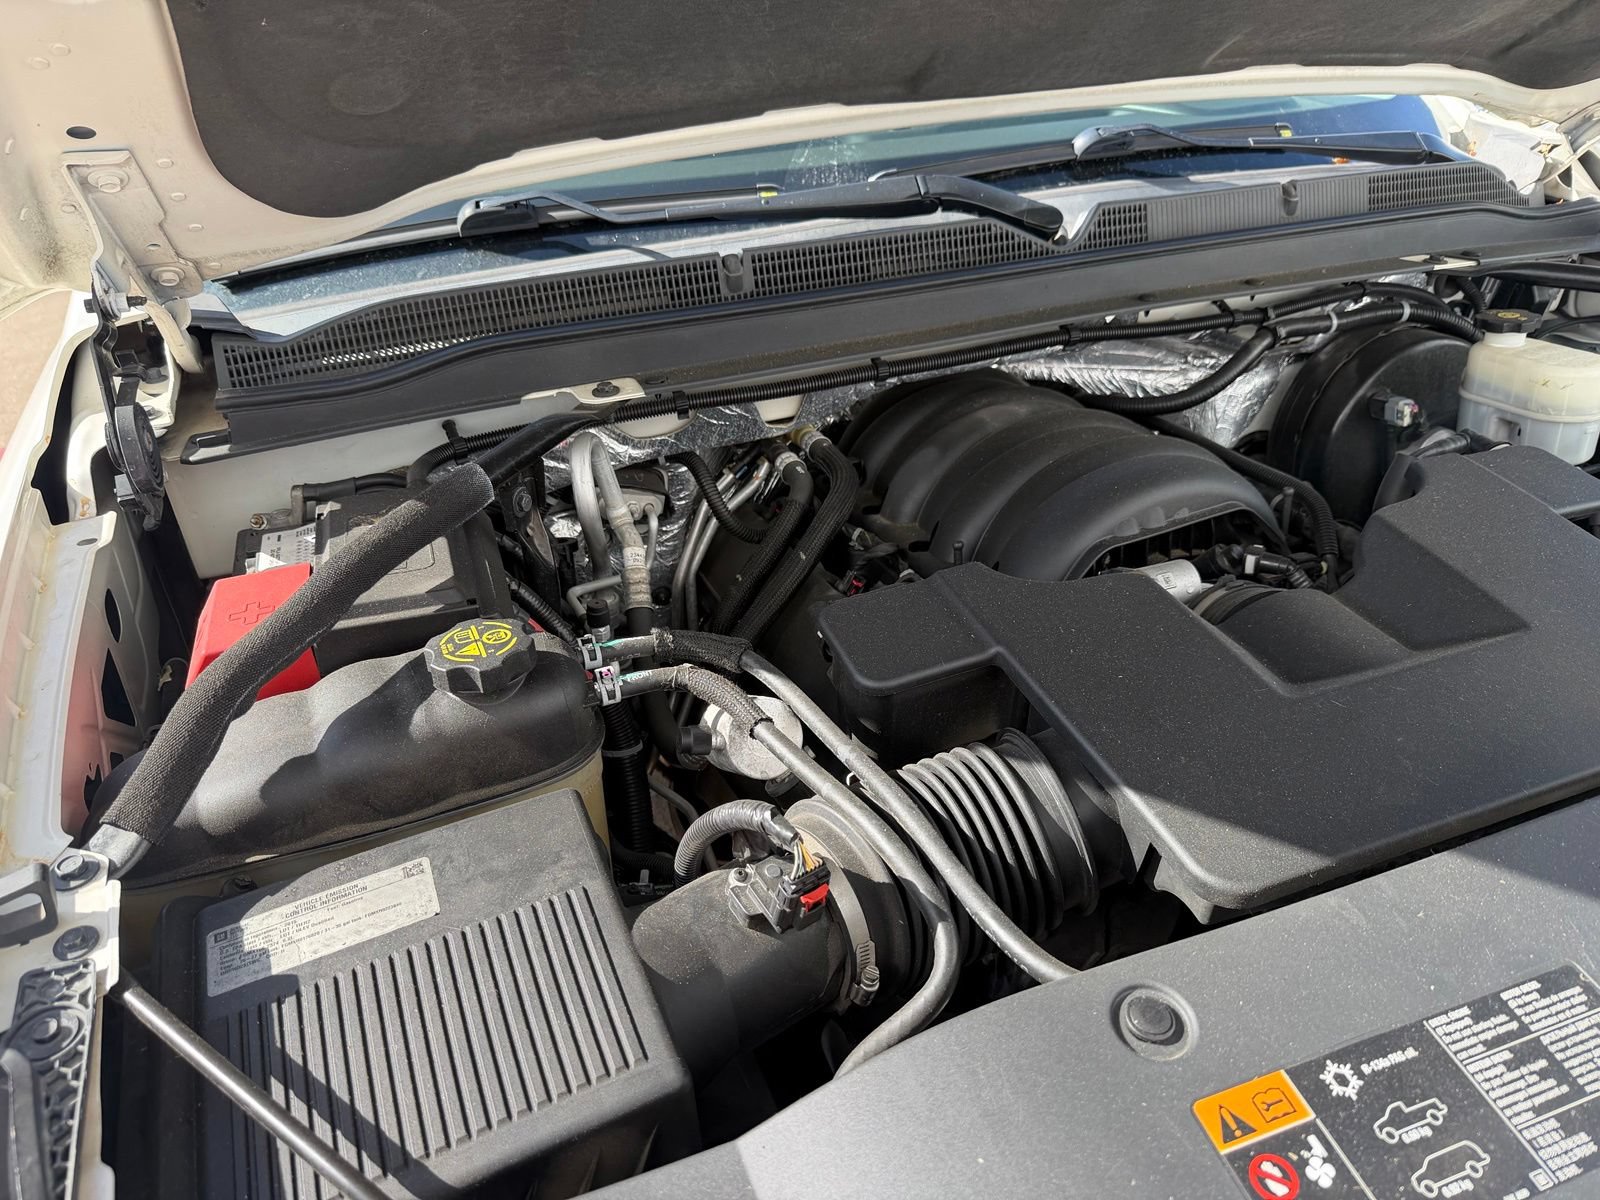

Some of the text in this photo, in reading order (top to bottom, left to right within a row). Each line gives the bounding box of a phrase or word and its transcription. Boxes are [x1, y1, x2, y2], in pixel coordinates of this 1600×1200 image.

[285, 886, 367, 918] CONTROL INFORMATION
[294, 884, 358, 909] VEHICLE EMISSION
